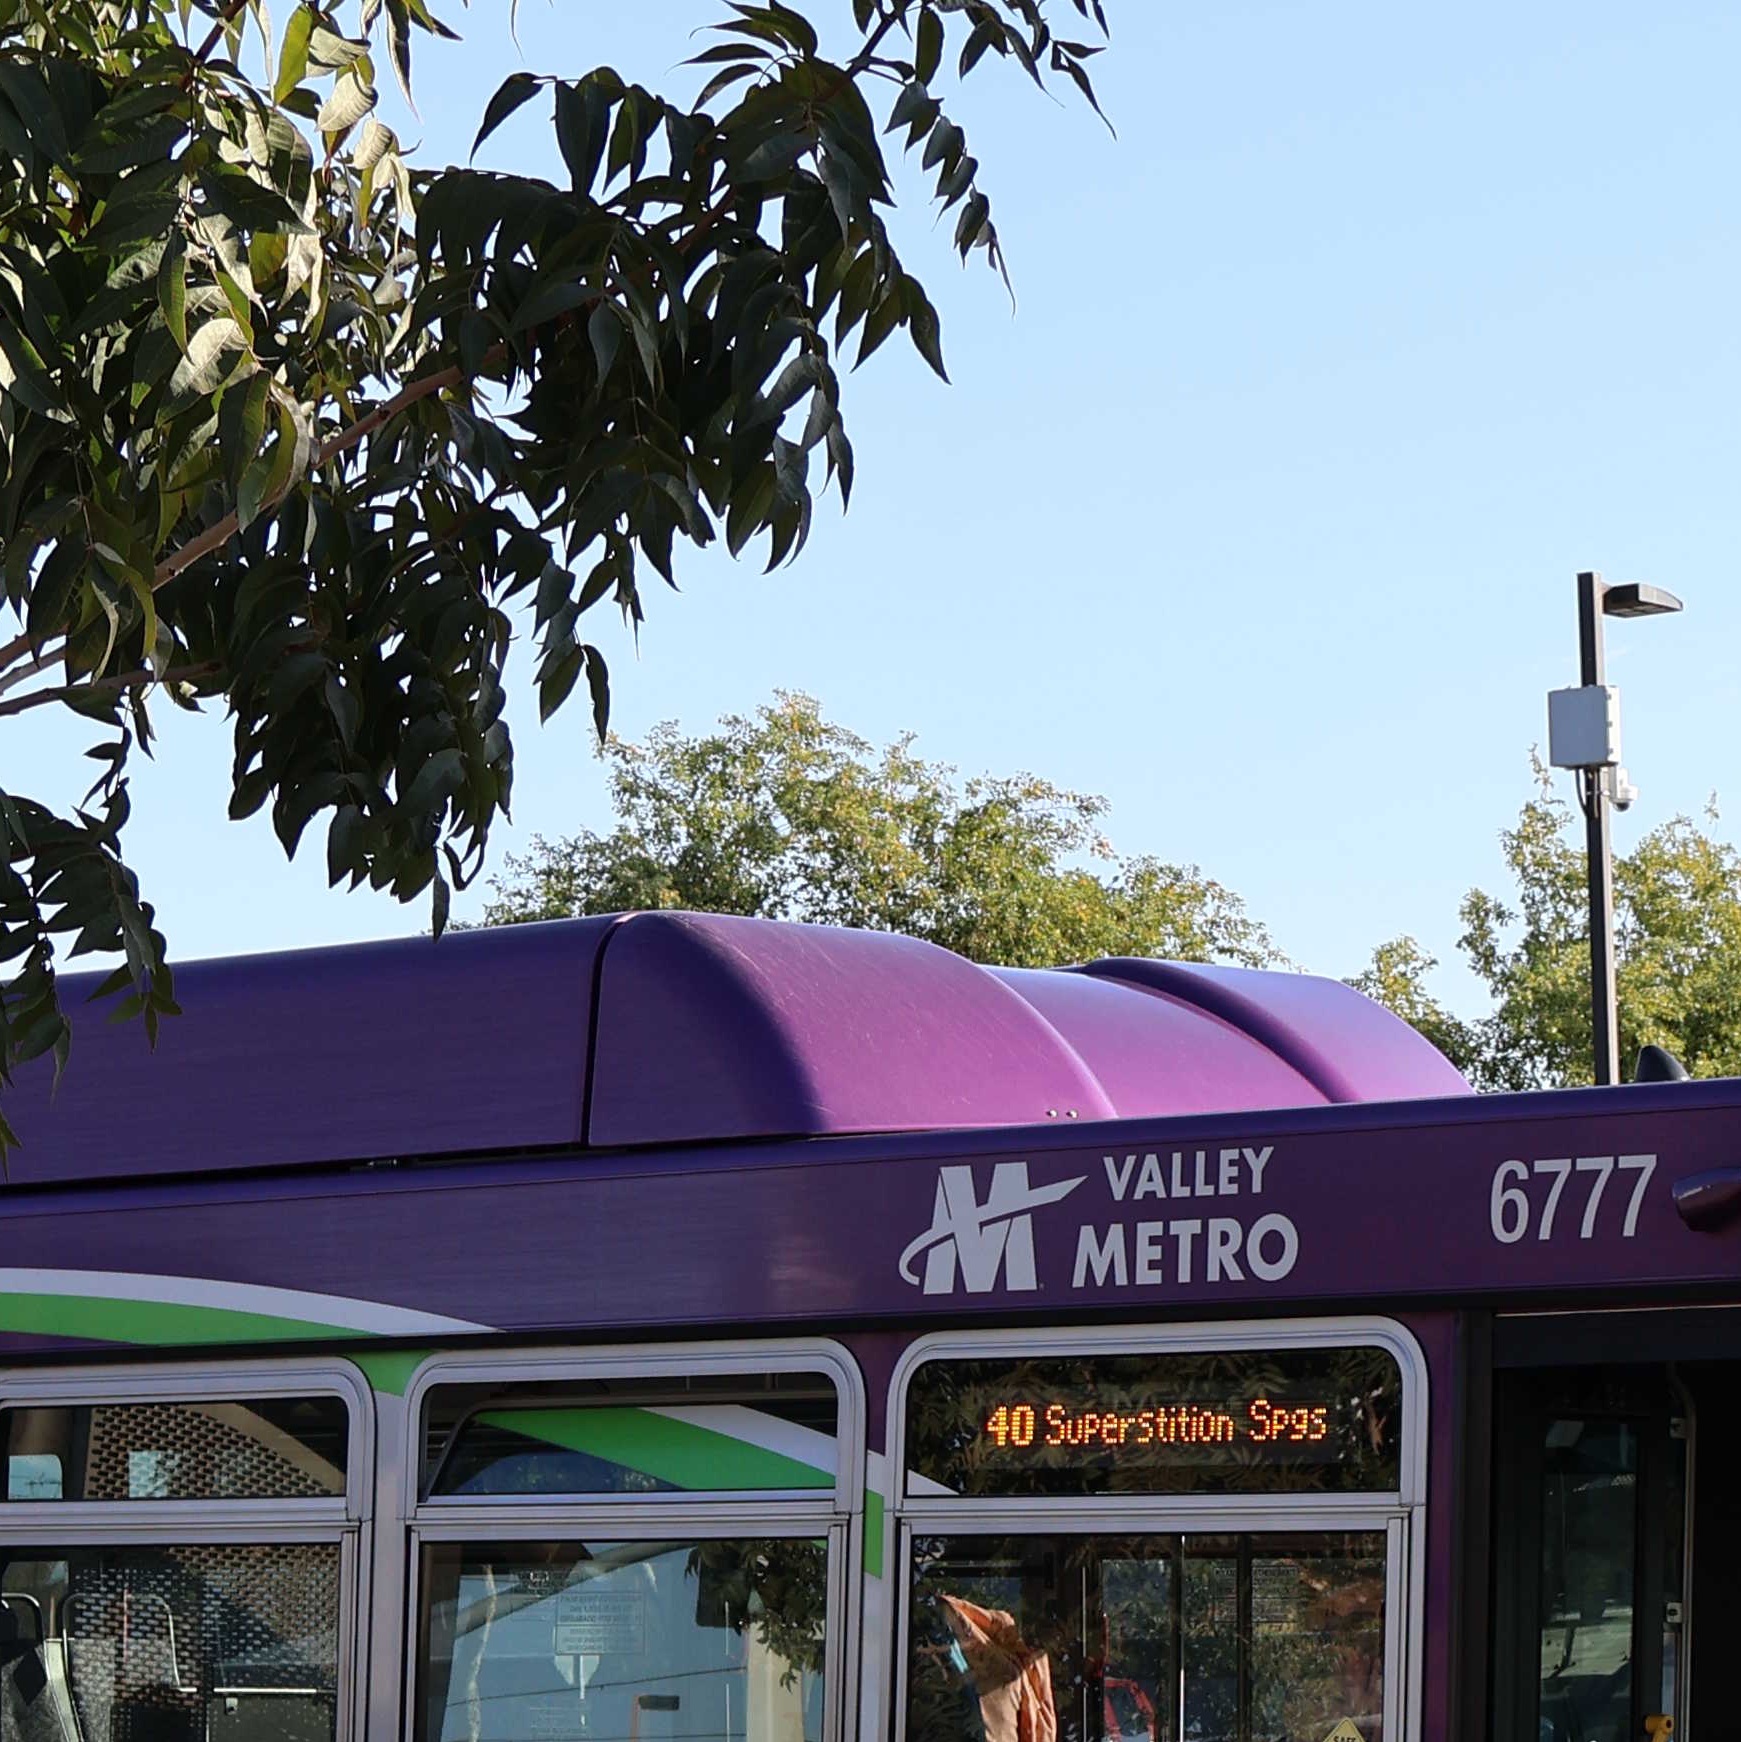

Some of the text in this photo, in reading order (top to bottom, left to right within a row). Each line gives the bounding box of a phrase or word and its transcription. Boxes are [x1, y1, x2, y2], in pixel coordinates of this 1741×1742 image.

[1103, 1146, 1275, 1202] VALLEY
[1489, 1153, 1658, 1244] 6777
[1071, 1213, 1299, 1288] METRO
[987, 1399, 1327, 1446] 40 Superstition Spgs
